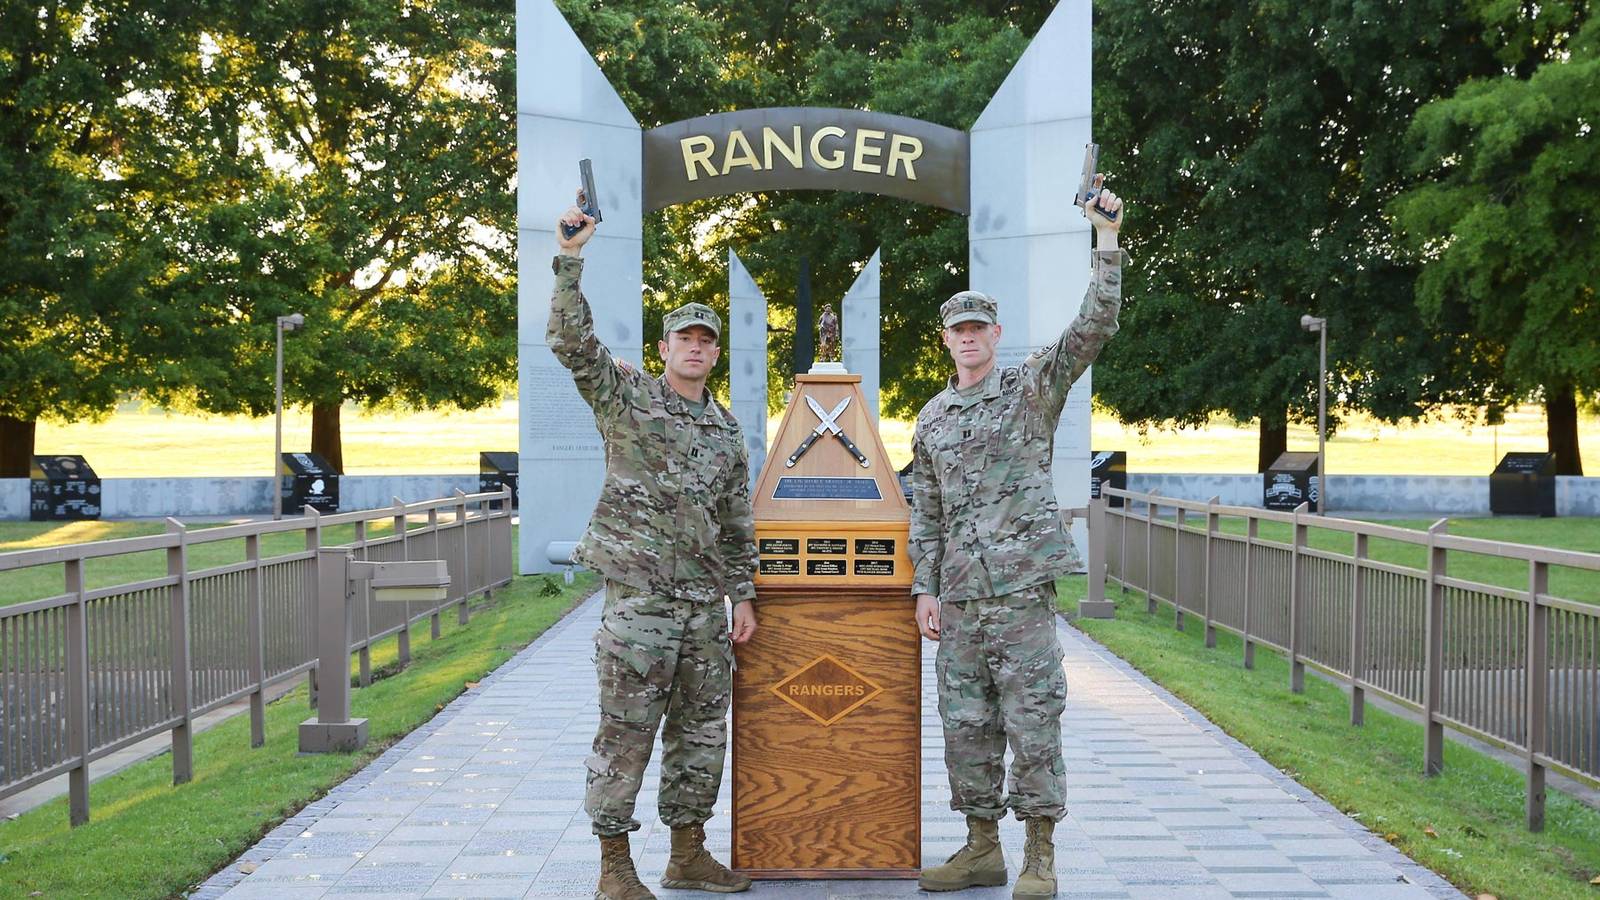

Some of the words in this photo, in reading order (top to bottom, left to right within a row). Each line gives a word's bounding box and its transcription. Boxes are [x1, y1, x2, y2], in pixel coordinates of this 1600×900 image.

[679, 125, 925, 181] RANGER
[1002, 386, 1018, 396] ARMY
[789, 684, 865, 696] RANGERS
